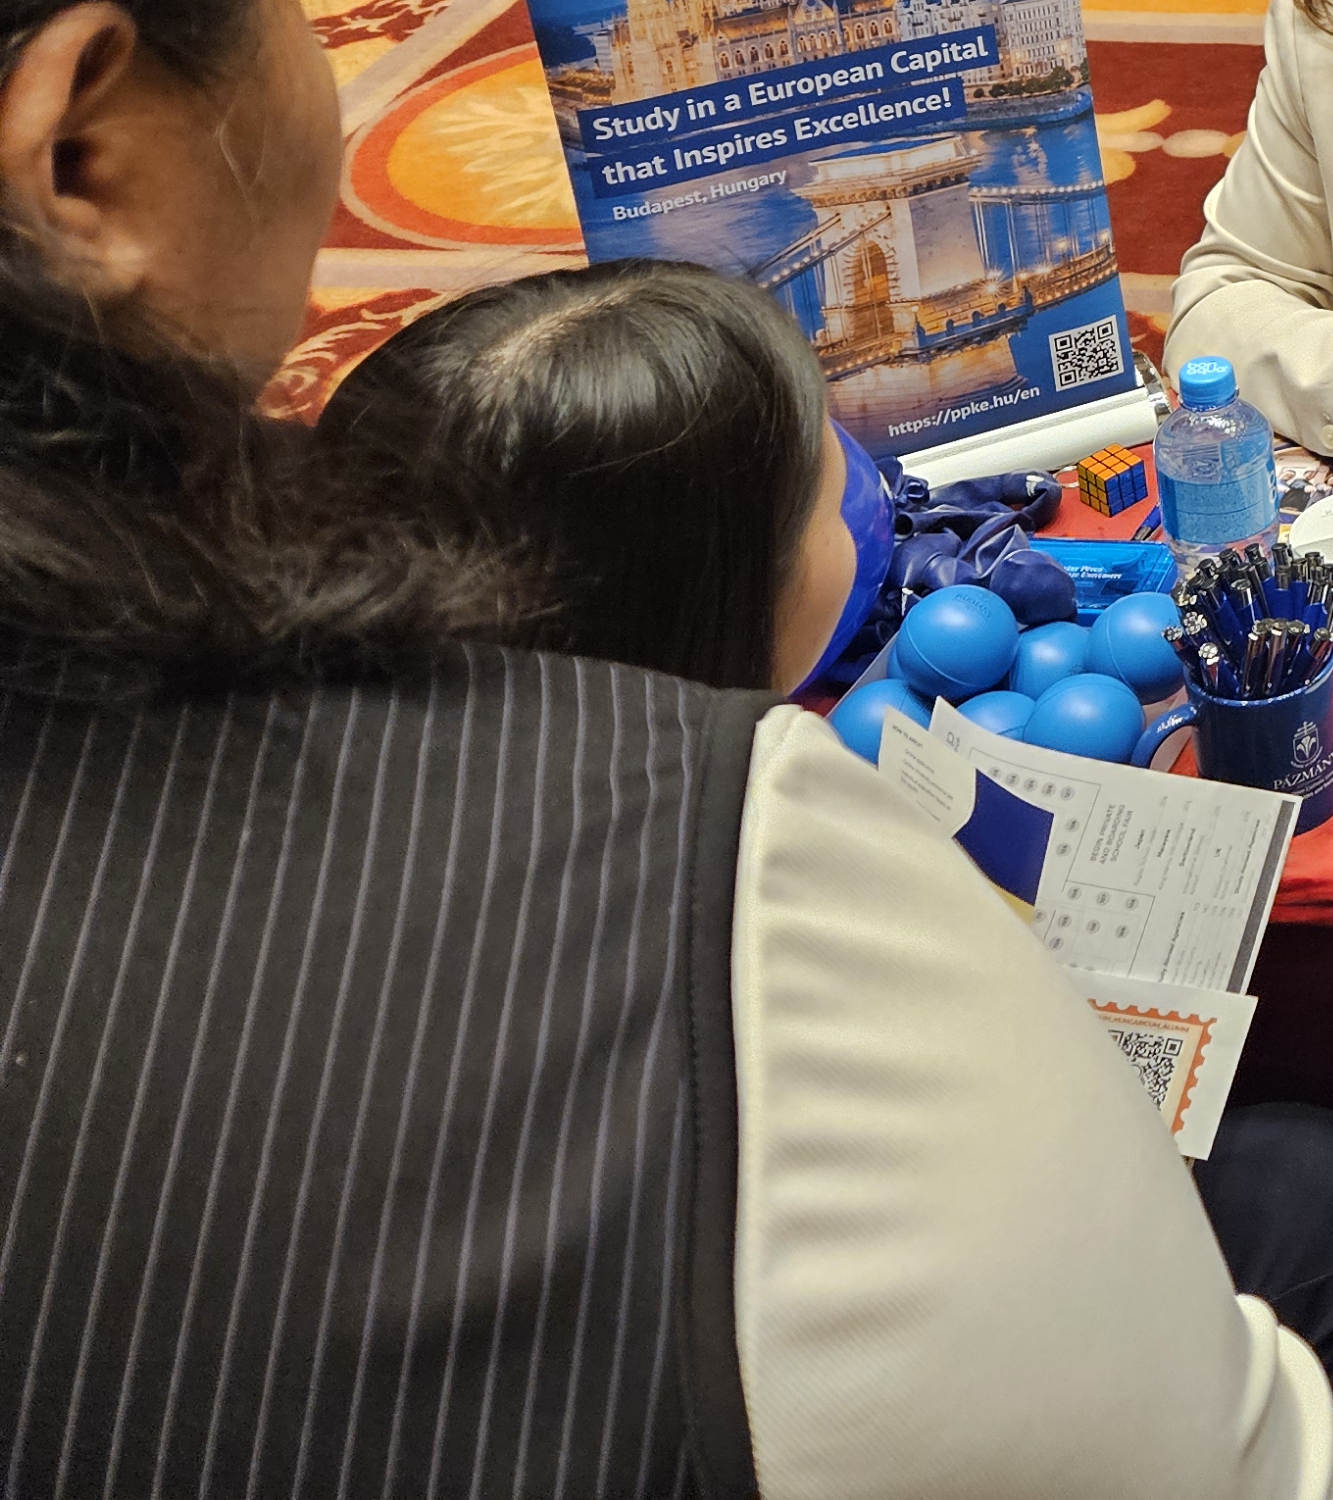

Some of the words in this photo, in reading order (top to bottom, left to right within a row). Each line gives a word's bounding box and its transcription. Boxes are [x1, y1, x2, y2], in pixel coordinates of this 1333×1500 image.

[593, 104, 680, 141] Study
[687, 97, 717, 119] in
[723, 94, 742, 111] a
[749, 60, 885, 106] European
[890, 36, 989, 75] Capital
[602, 155, 667, 186] that
[674, 128, 788, 171] Inspires
[794, 86, 952, 141] Excellence!
[613, 191, 707, 221] Budapest,
[709, 168, 787, 204] Hungary
[888, 385, 1040, 437] https://ppke.hu/en
